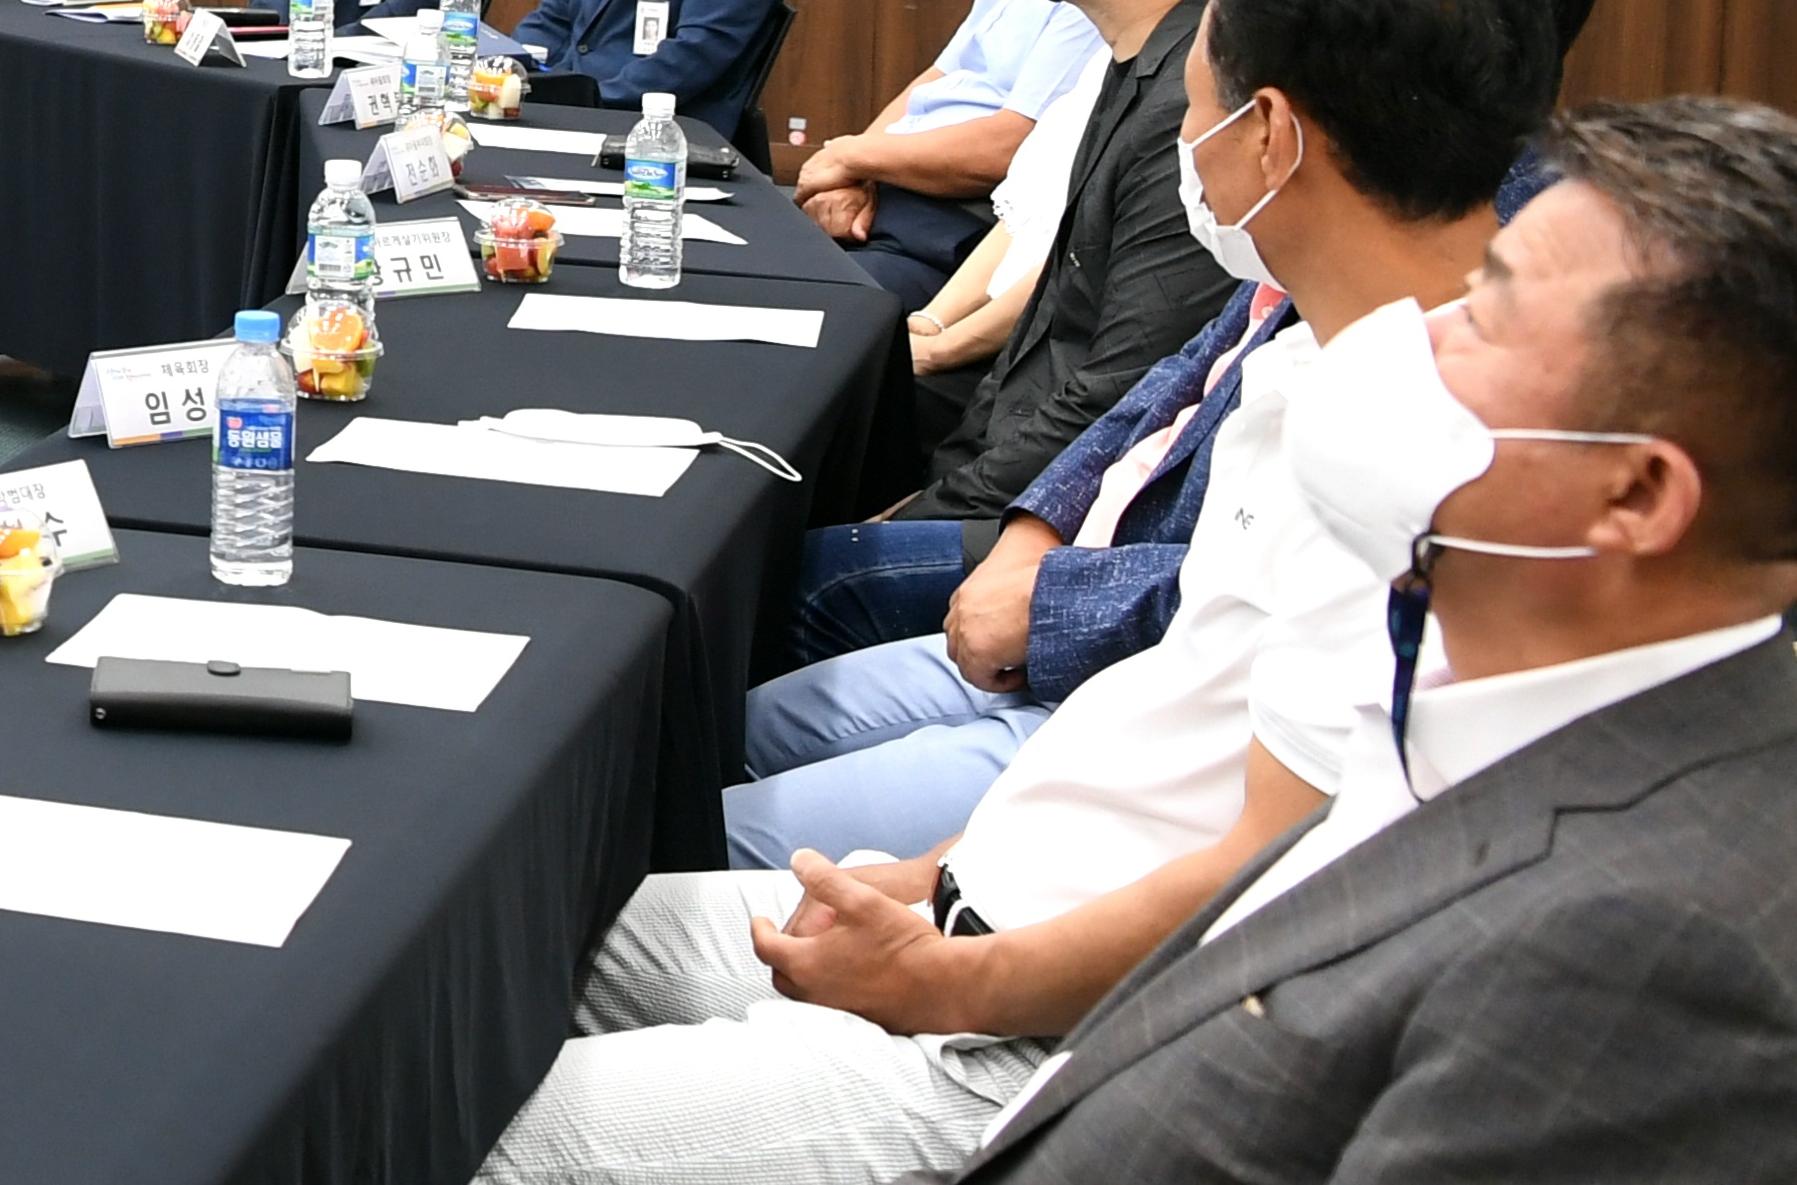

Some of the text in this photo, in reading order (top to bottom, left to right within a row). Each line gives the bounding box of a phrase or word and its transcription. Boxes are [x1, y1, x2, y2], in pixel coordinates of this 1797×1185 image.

[160, 359, 210, 377] 체육회장
[144, 386, 208, 426] 임성
[227, 429, 283, 449] 동원샘물
